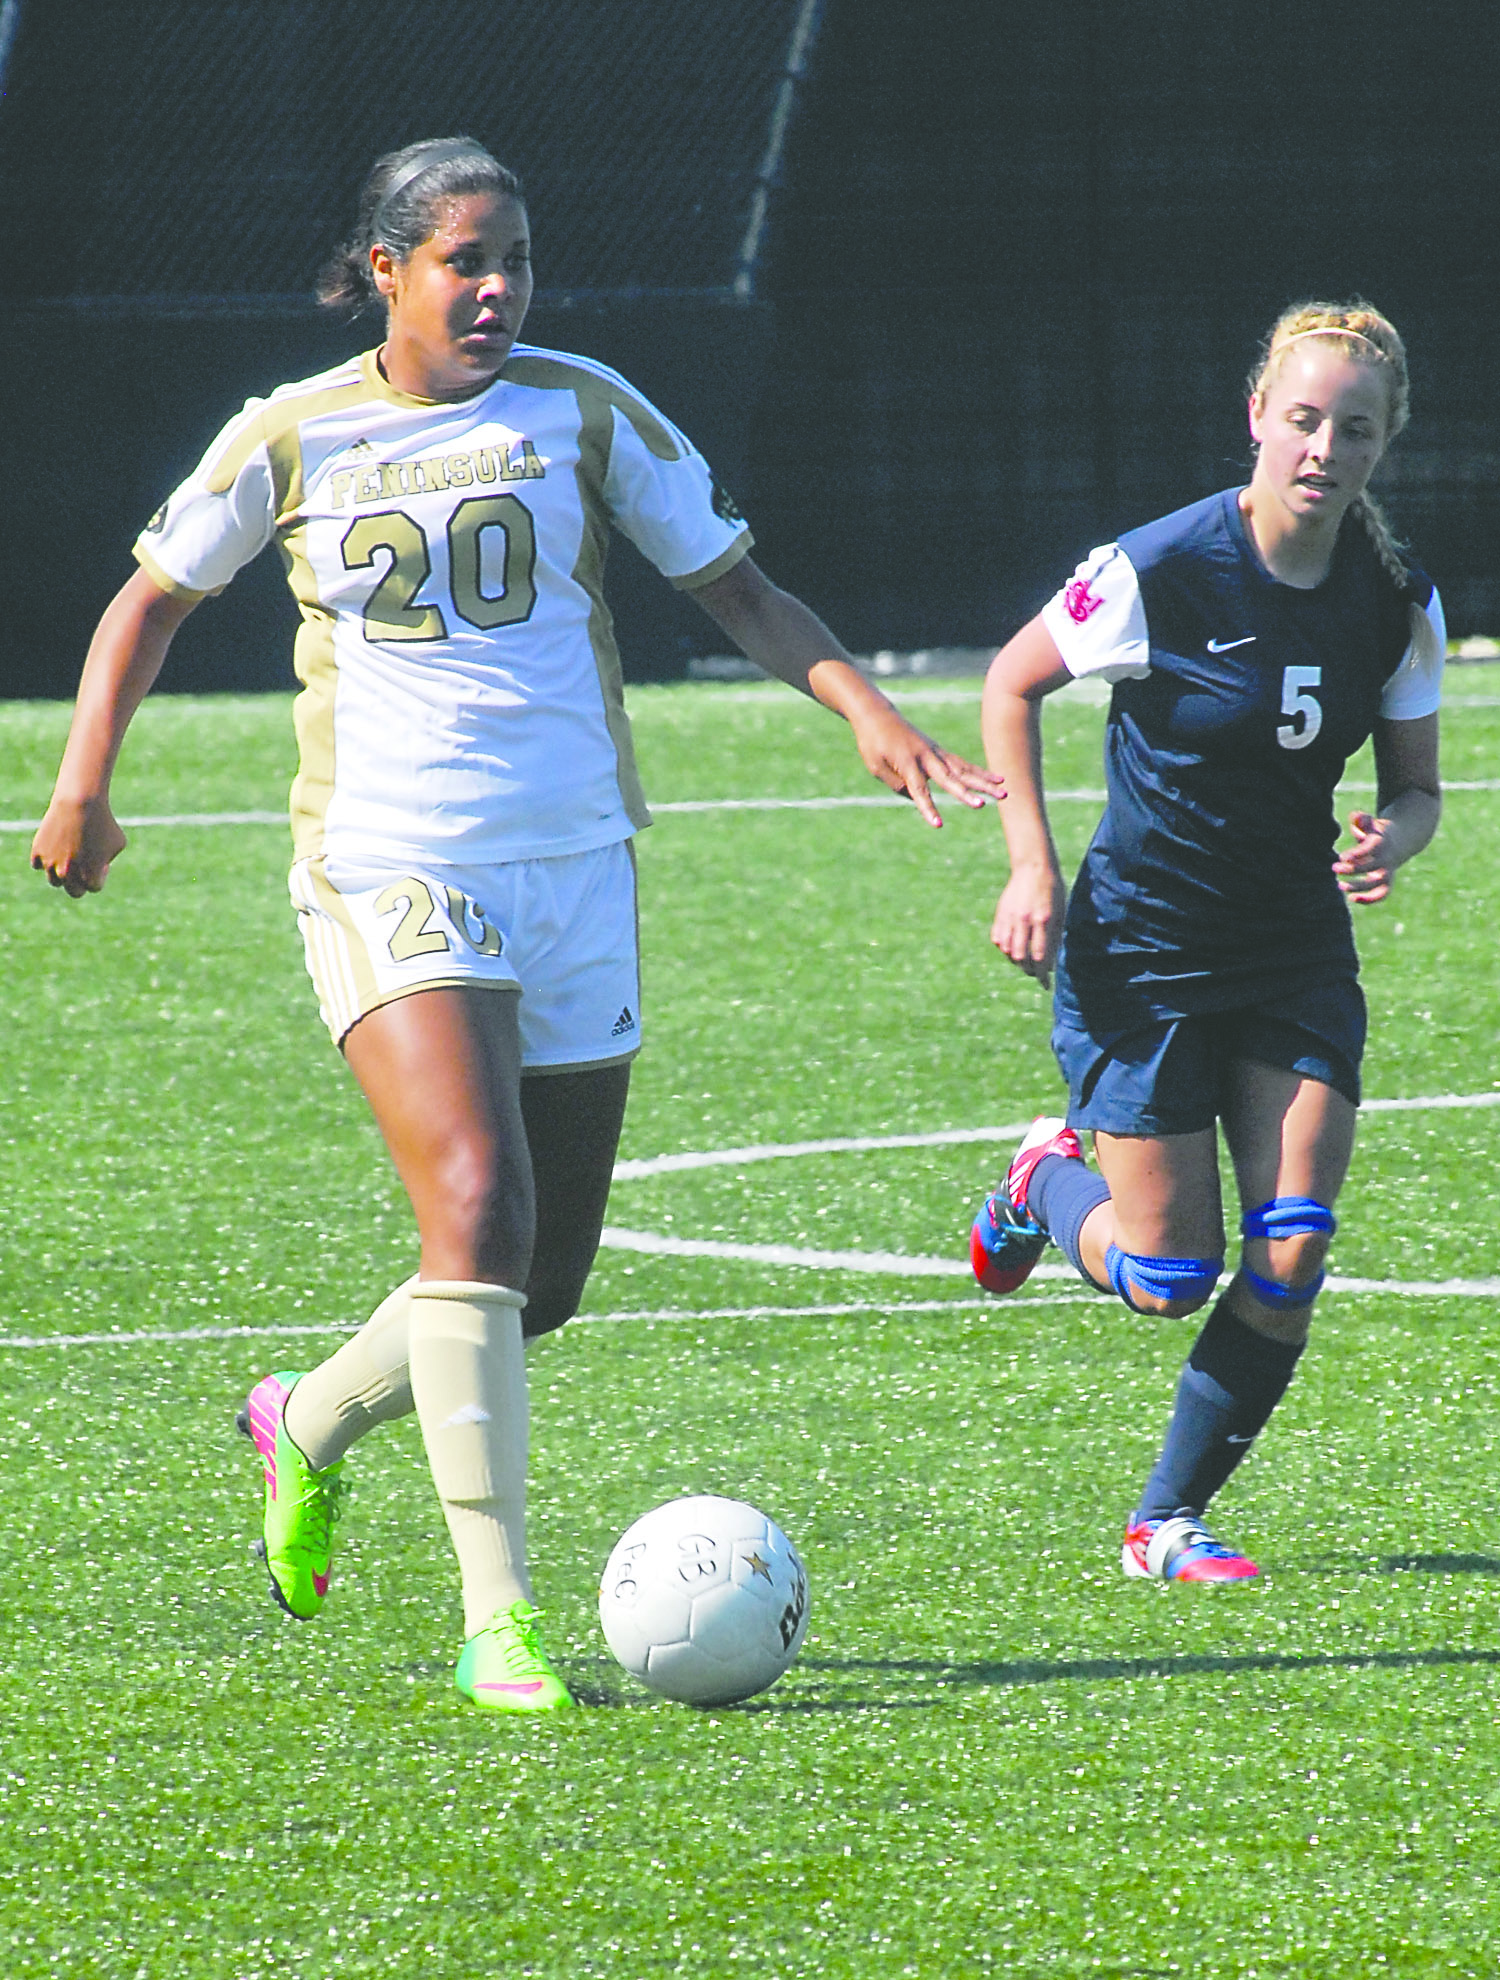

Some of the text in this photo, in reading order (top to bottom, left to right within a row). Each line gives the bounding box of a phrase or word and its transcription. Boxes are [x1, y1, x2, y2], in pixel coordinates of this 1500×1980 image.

[331, 441, 545, 509] PENINSULA
[340, 492, 537, 643] 20
[1276, 665, 1323, 750] 5
